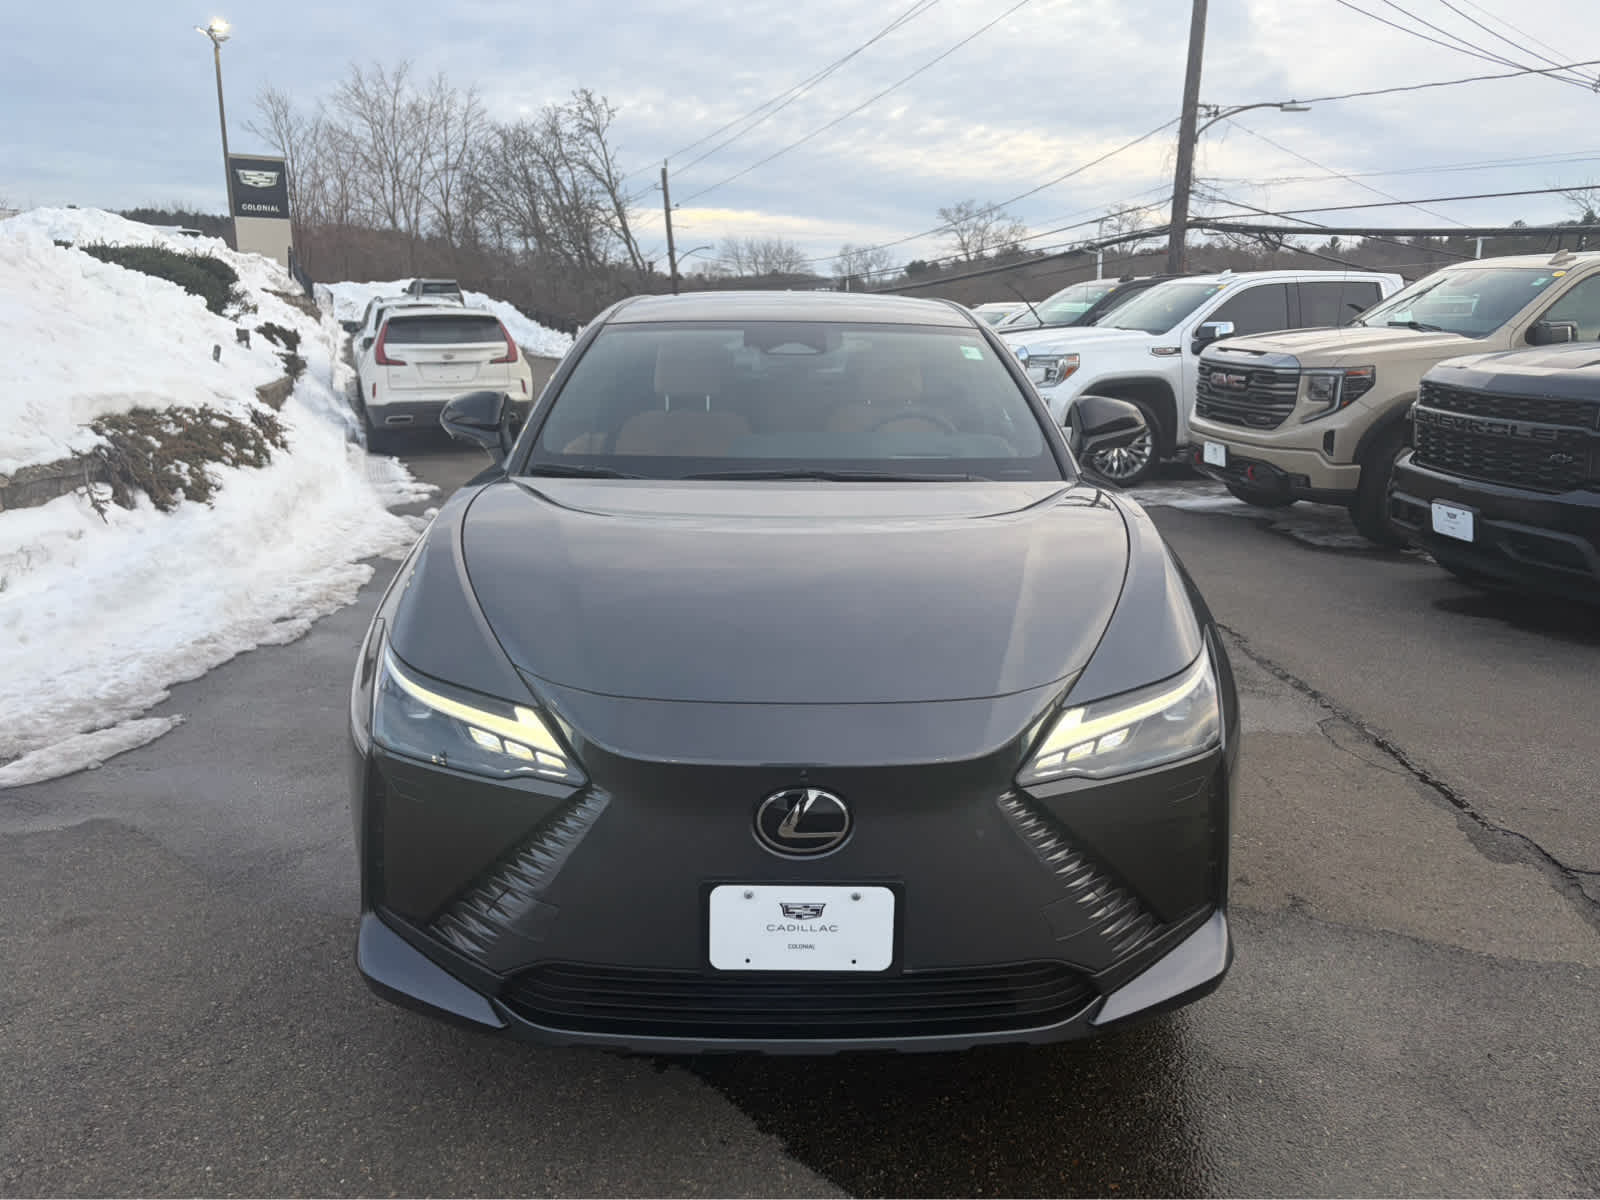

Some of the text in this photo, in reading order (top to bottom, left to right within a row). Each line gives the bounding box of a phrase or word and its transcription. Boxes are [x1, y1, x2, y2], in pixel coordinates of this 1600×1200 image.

[241, 203, 280, 212] COLONIAL
[1210, 372, 1247, 389] GMC
[766, 923, 839, 933] CADILLAC
